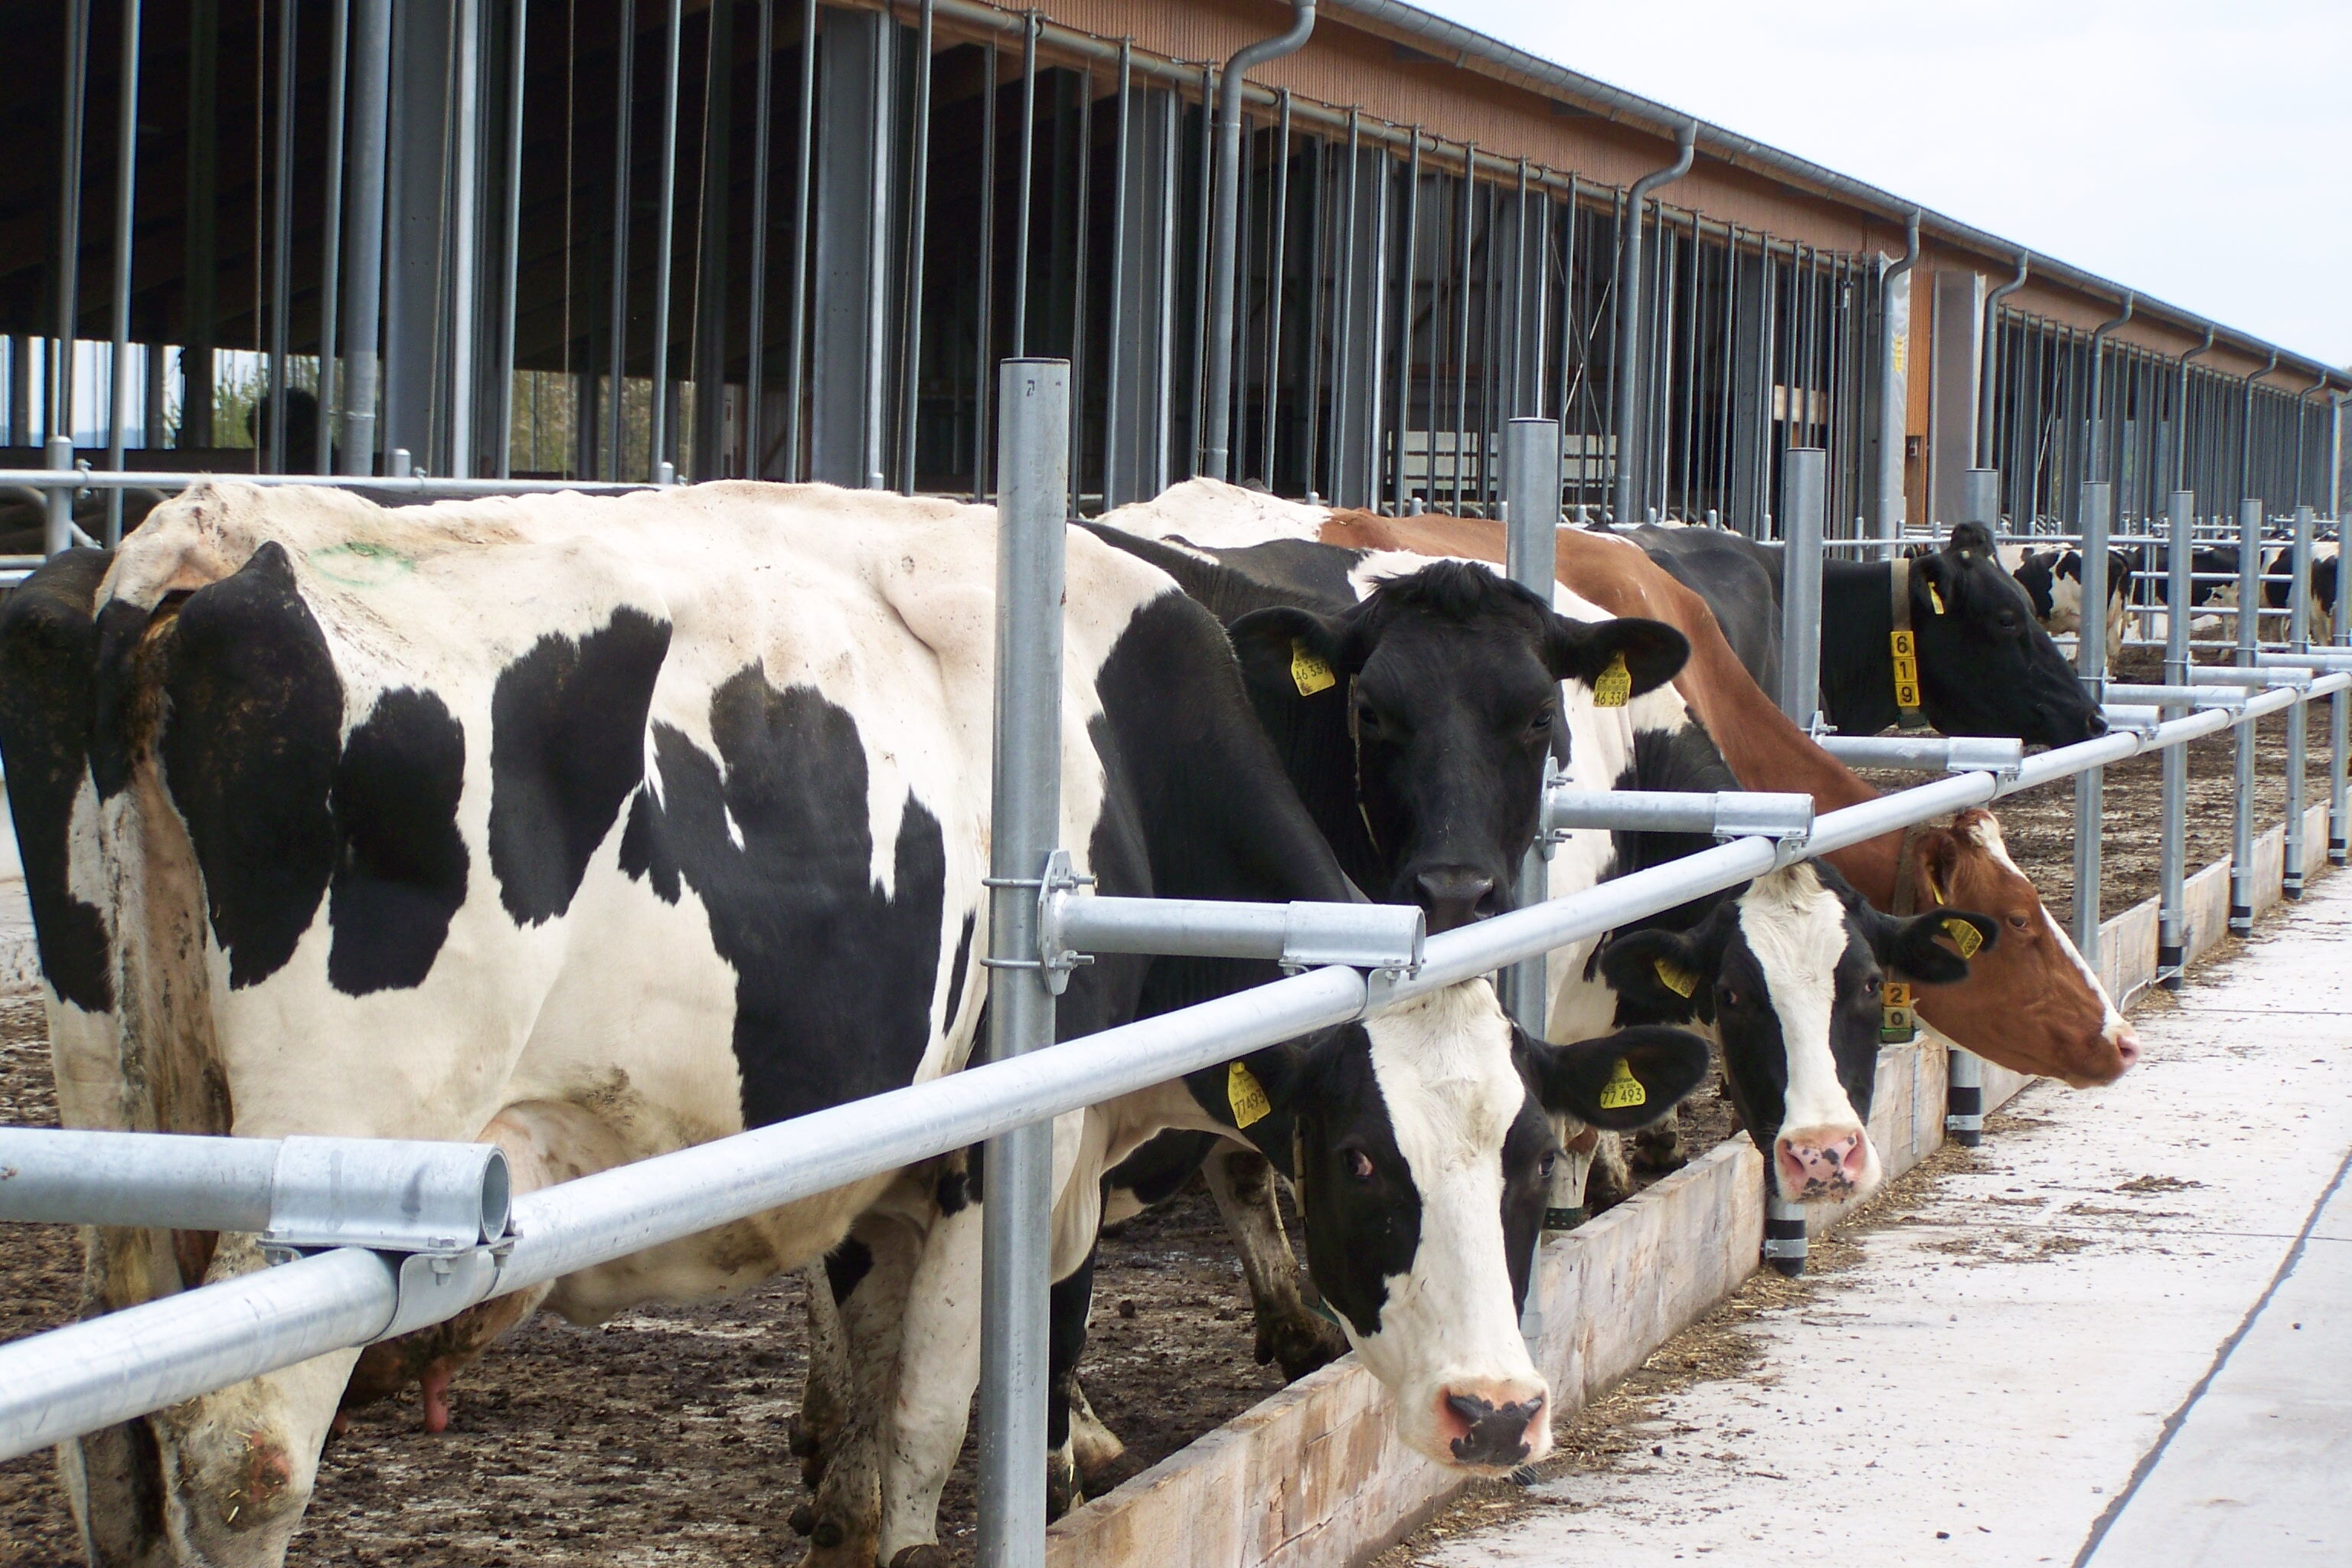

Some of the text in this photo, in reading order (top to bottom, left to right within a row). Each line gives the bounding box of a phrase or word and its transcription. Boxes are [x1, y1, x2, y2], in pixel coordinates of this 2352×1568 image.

[1295, 668, 1308, 682] 46
[1594, 692, 1606, 705] 46
[1603, 1087, 1642, 1104] 77 493
